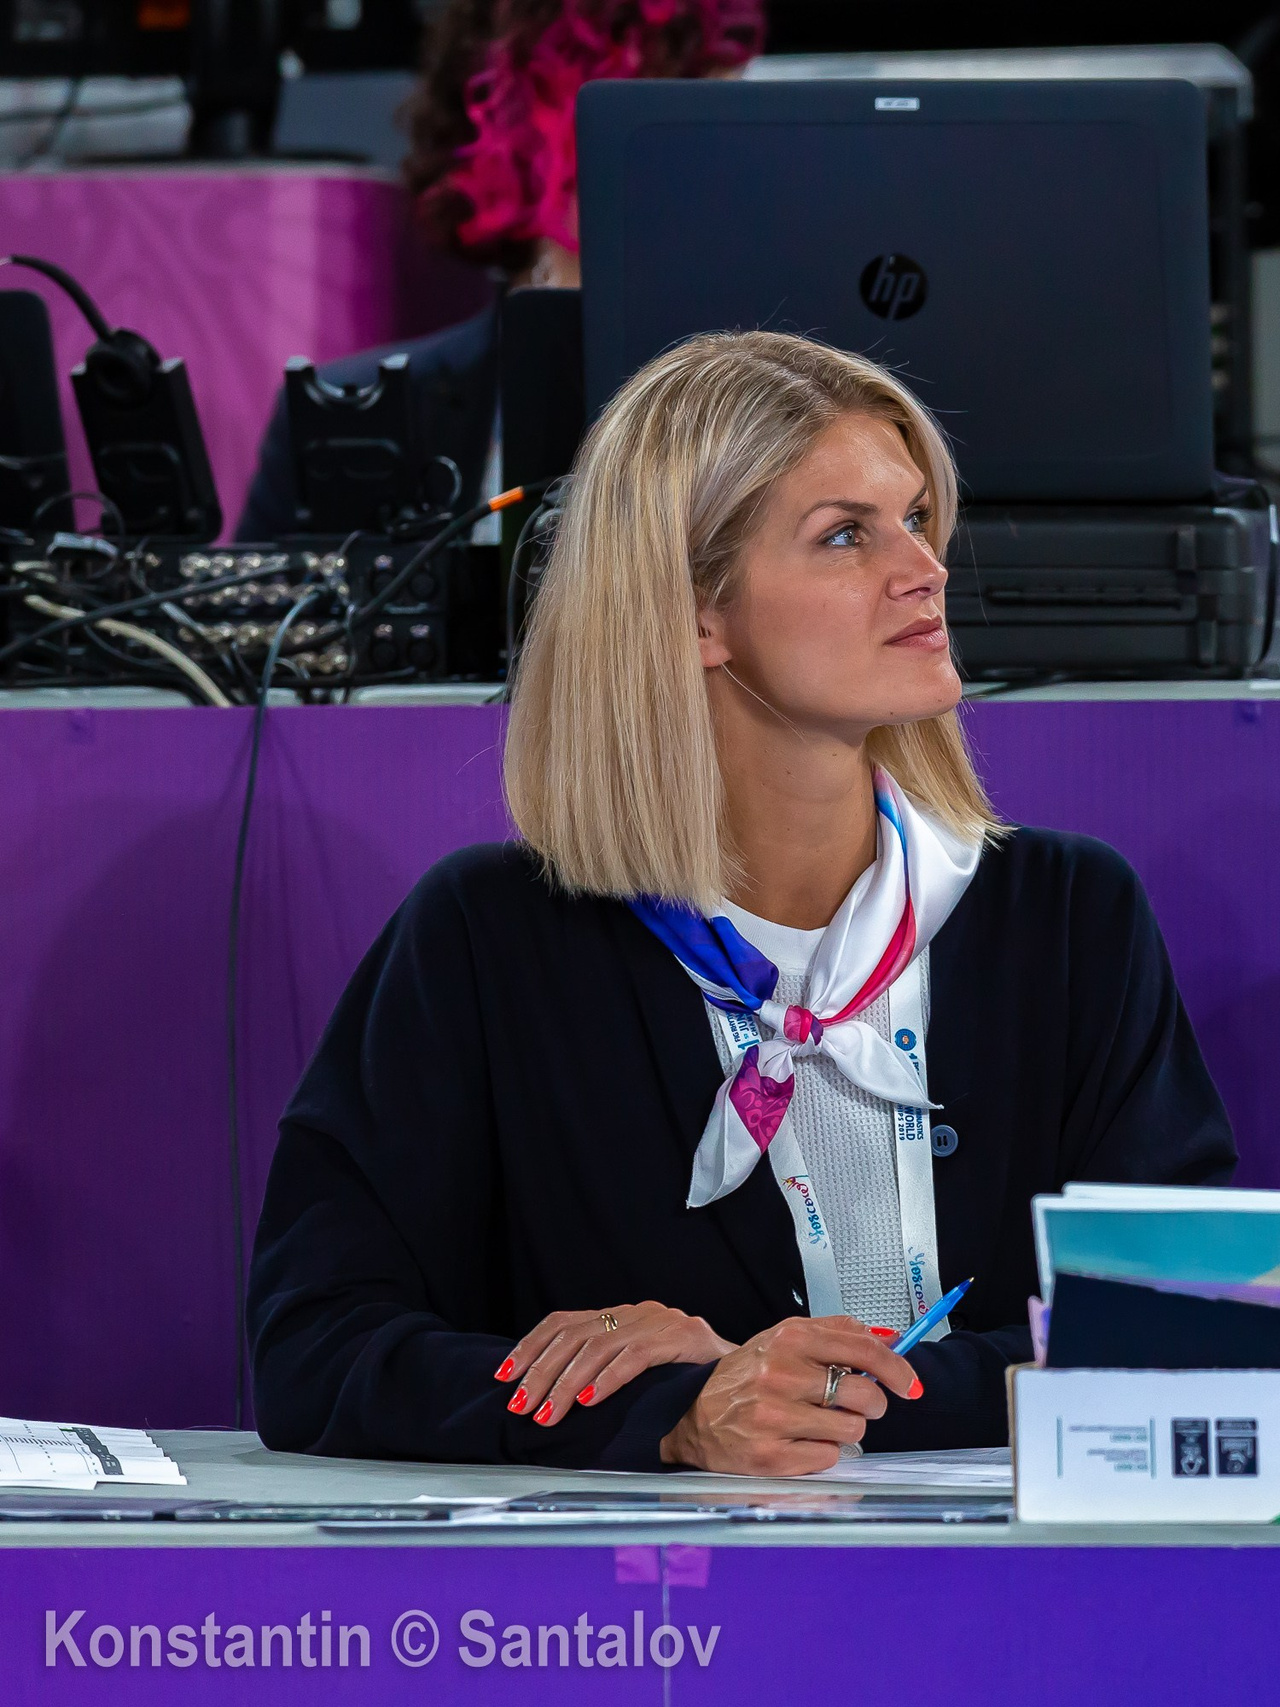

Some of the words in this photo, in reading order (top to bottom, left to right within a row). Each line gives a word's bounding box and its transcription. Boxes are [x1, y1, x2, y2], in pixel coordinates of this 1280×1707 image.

[868, 254, 921, 320] hp
[732, 1032, 741, 1042] FIG
[904, 1105, 916, 1141] WORLD
